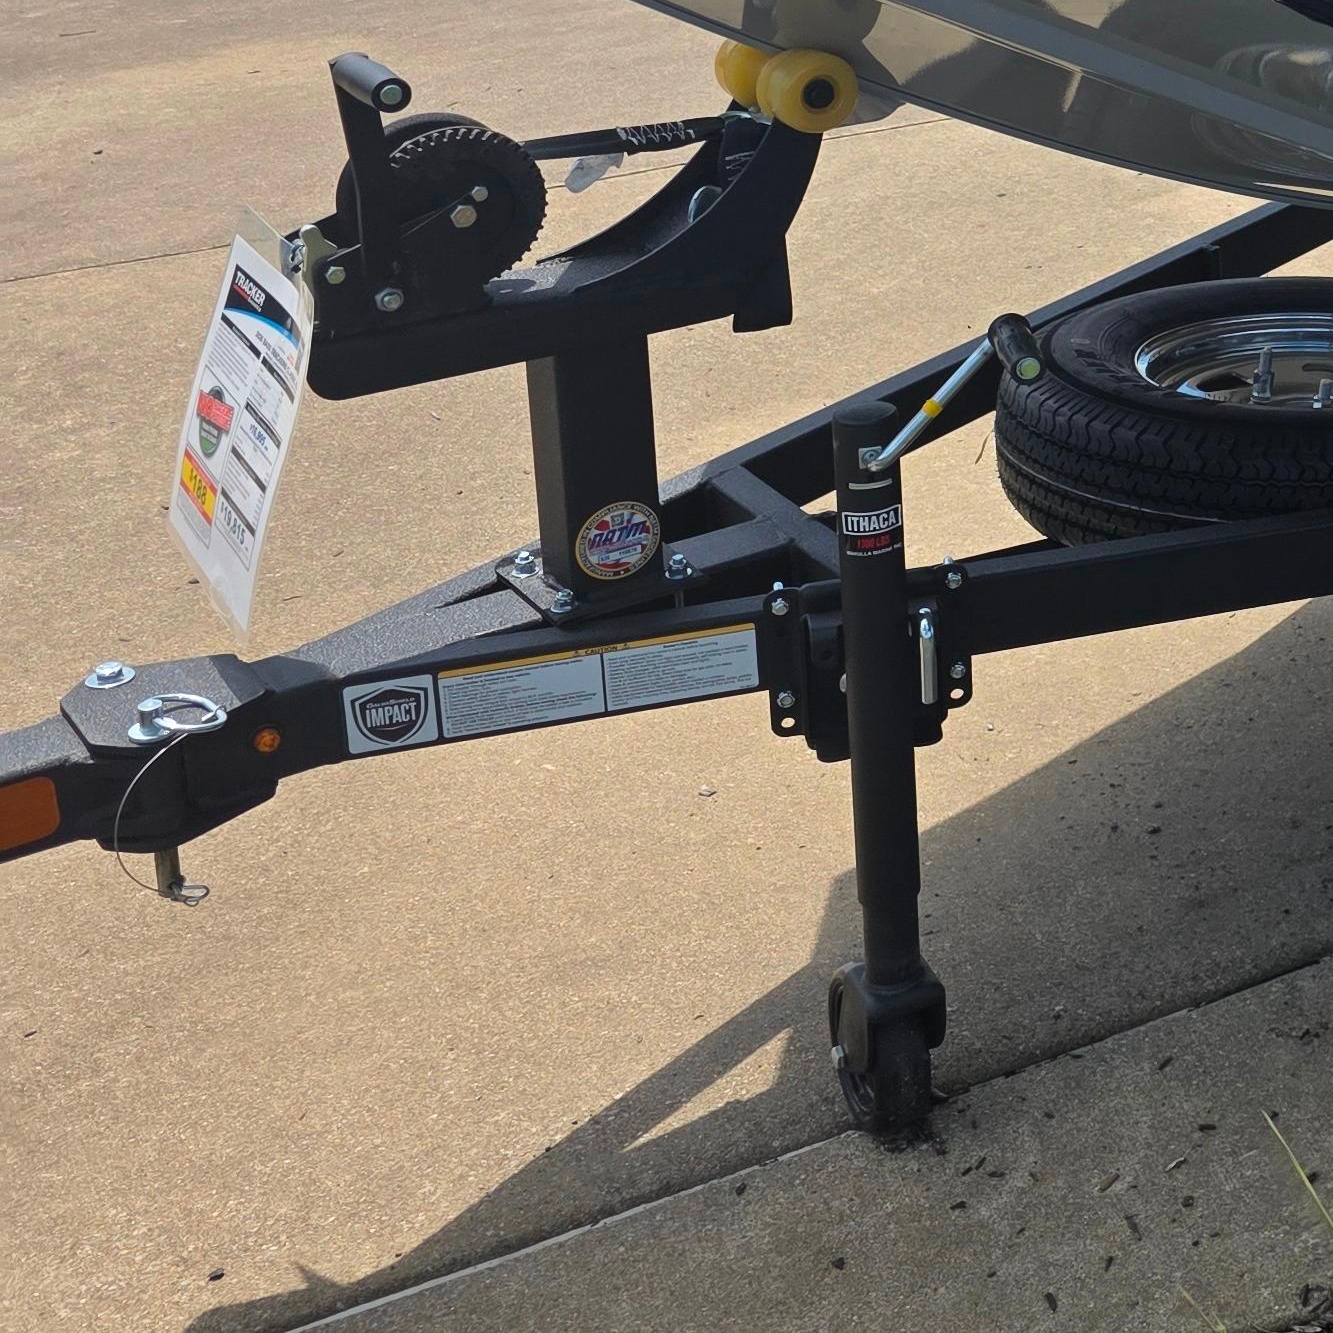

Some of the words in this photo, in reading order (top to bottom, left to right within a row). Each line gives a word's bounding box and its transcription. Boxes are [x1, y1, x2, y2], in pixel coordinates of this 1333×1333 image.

[235, 270, 266, 307] TRACKER
[847, 510, 896, 532] ITHACA
[585, 645, 618, 654] CAUTION
[365, 702, 417, 727] IMPACT
